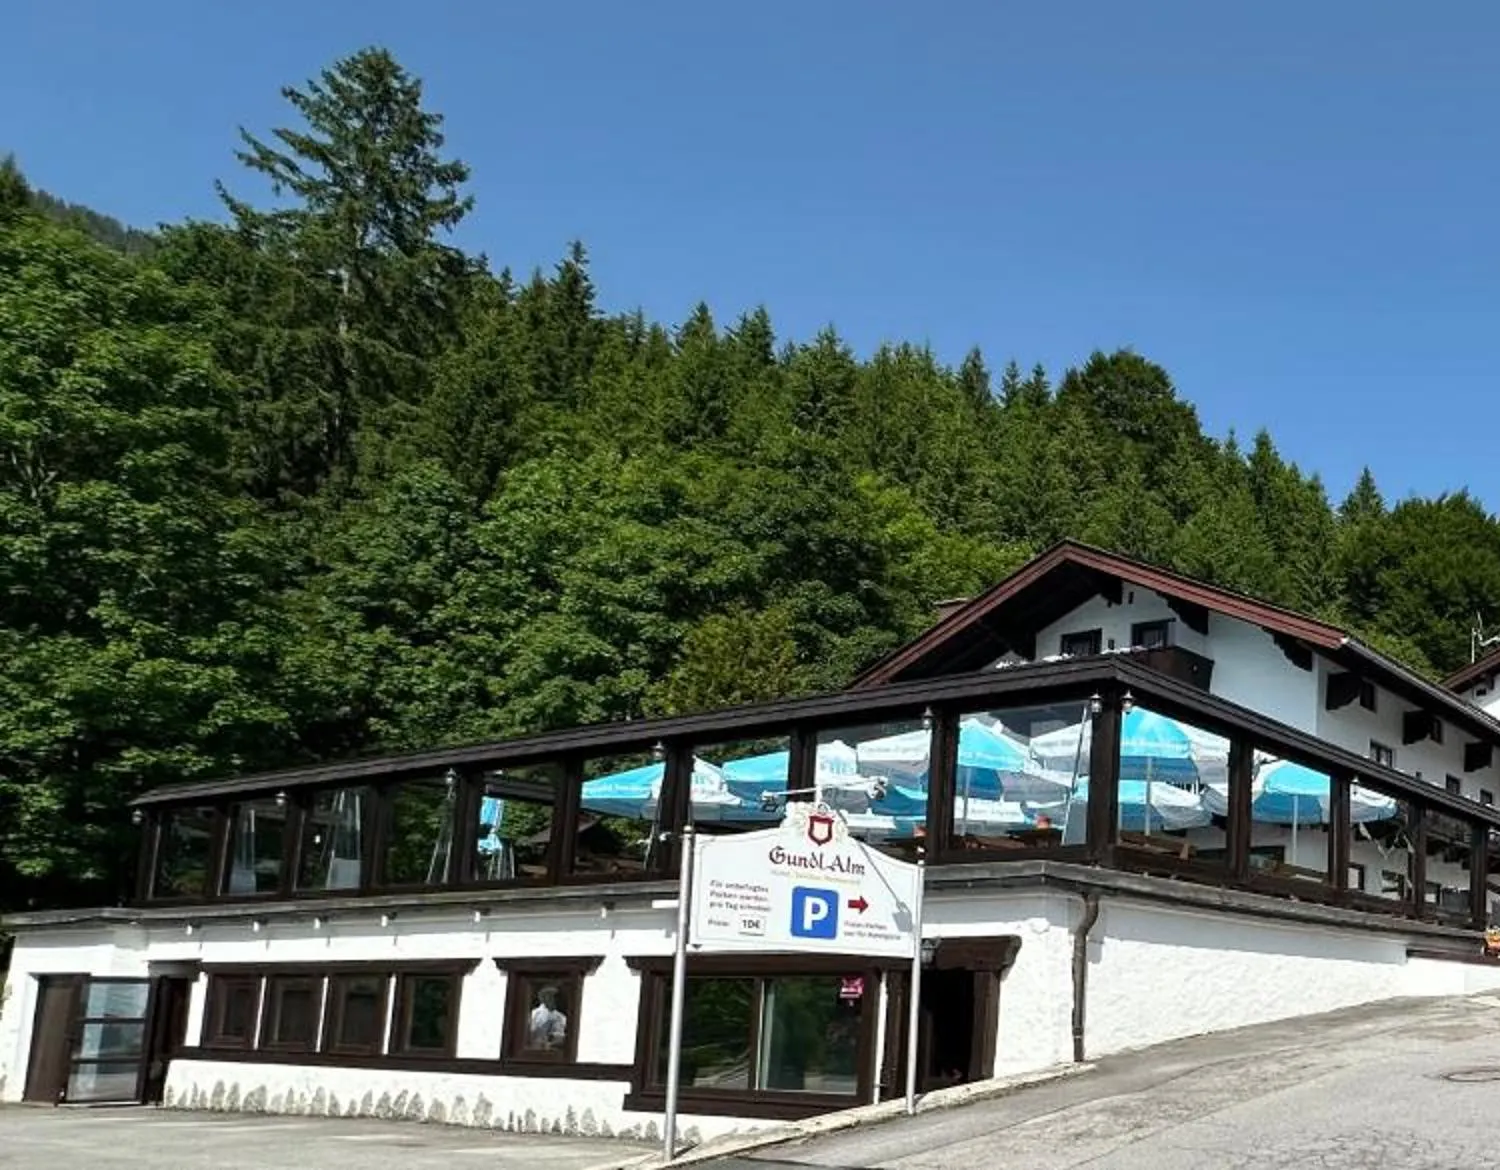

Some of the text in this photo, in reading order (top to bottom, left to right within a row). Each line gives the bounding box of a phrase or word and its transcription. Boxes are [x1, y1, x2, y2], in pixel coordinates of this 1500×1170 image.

[769, 845, 865, 875] Gundl Alm
[803, 896, 829, 930] P
